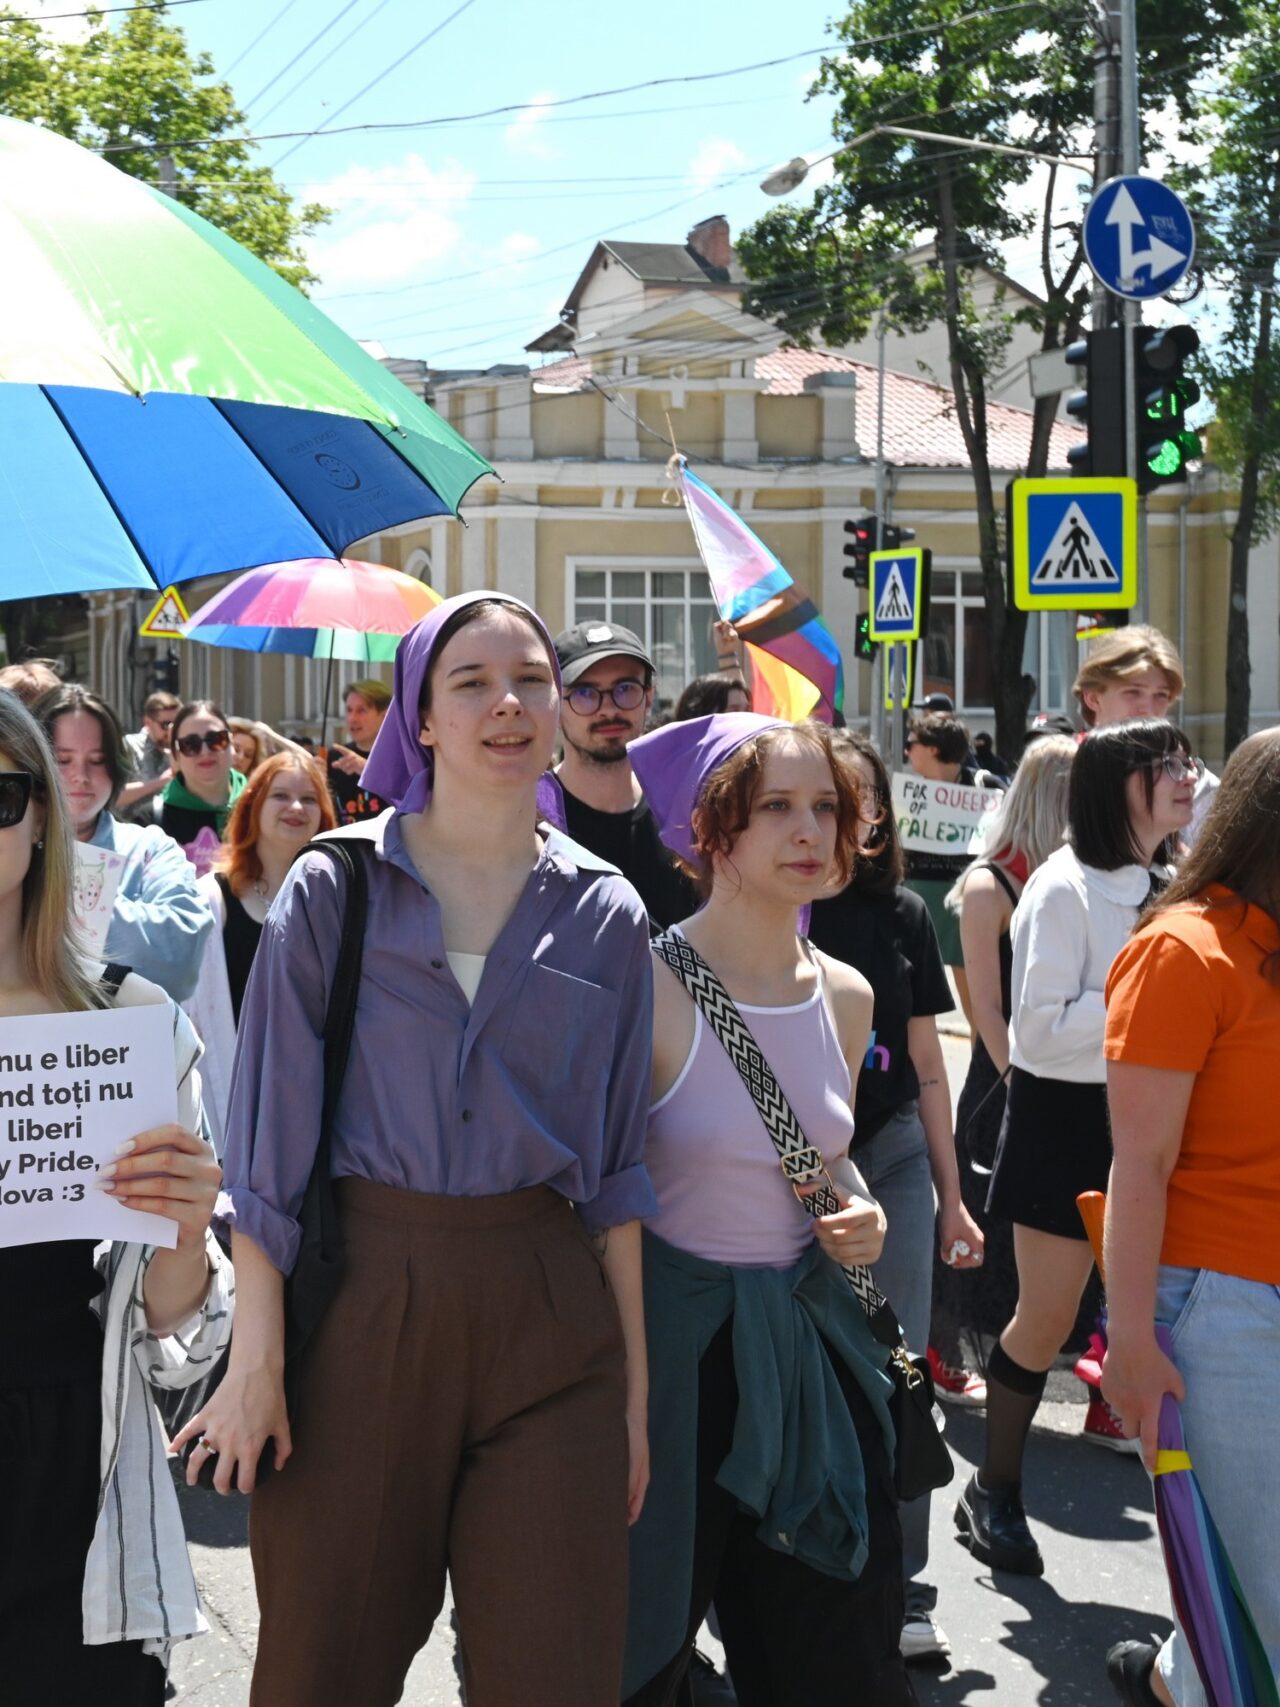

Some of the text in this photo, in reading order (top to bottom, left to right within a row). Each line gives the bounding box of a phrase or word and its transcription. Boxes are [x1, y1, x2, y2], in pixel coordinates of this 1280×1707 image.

[903, 781, 928, 800] FOR
[909, 801, 928, 815] OF
[40, 1052, 58, 1071] e
[65, 1043, 130, 1069] liber
[99, 1081, 134, 1102] nu
[8, 1115, 82, 1142] liberi
[18, 1150, 100, 1174] Pride,
[62, 1183, 85, 1202] :3
